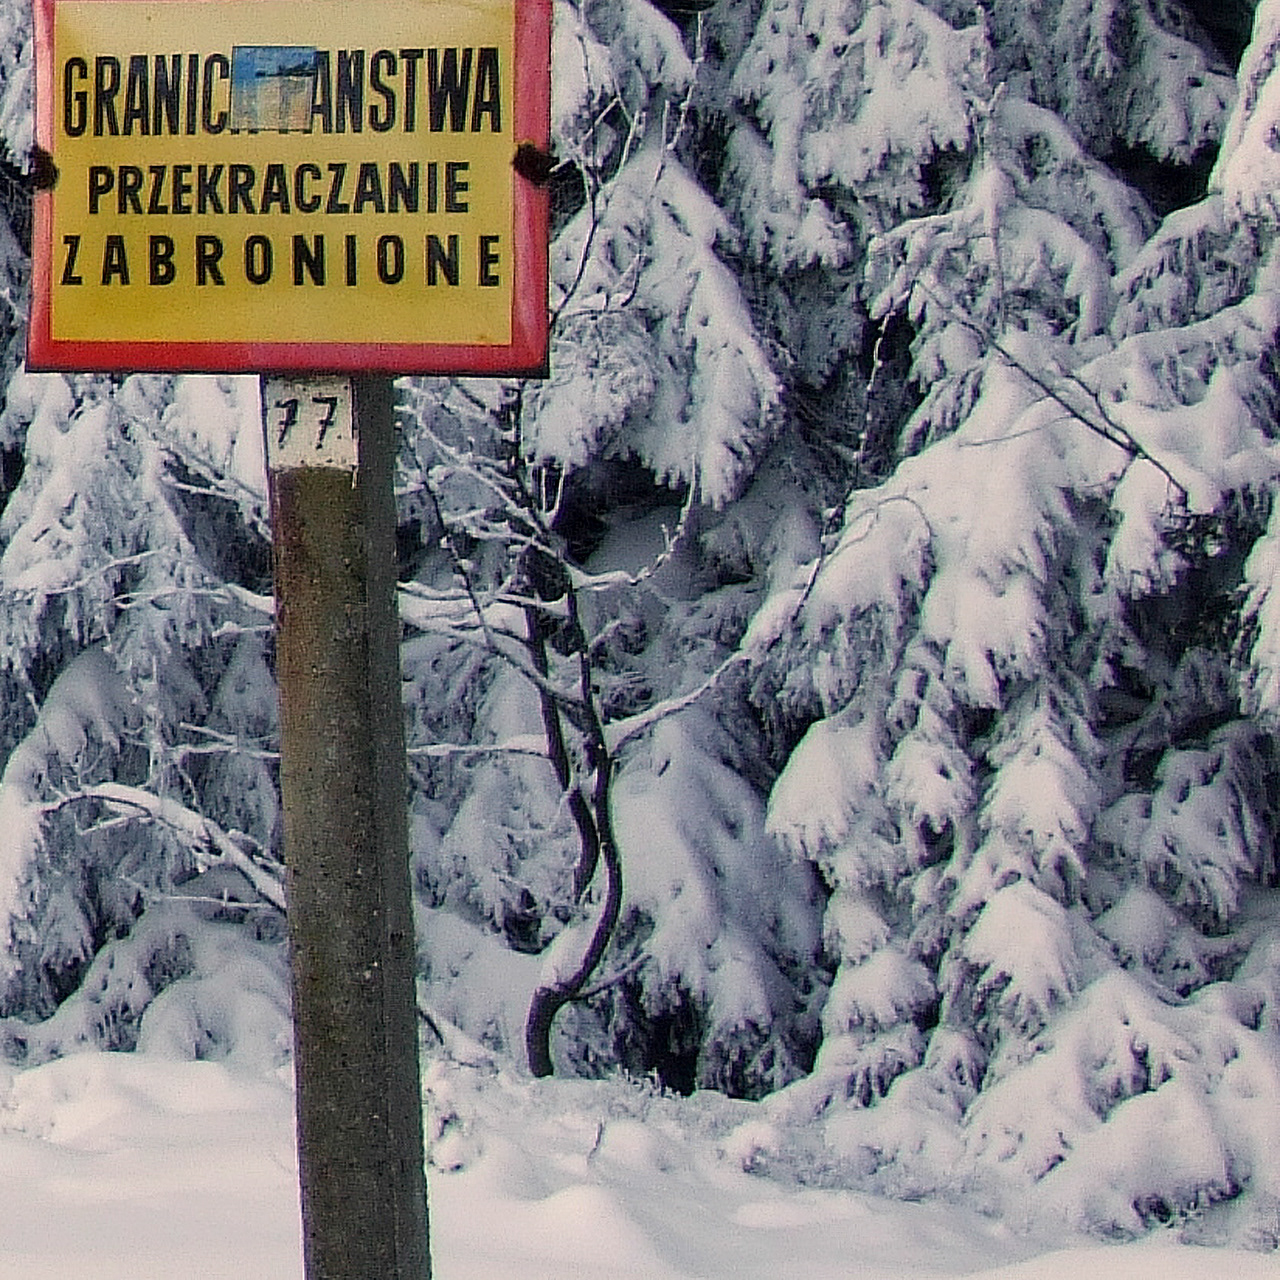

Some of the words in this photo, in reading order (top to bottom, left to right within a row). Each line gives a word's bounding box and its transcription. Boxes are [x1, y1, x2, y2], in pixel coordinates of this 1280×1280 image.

[64, 53, 260, 136] GRANIC
[87, 161, 470, 215] PRZEKRACZANIE
[60, 234, 500, 287] ZABRONIONE
[274, 396, 338, 449] 77
